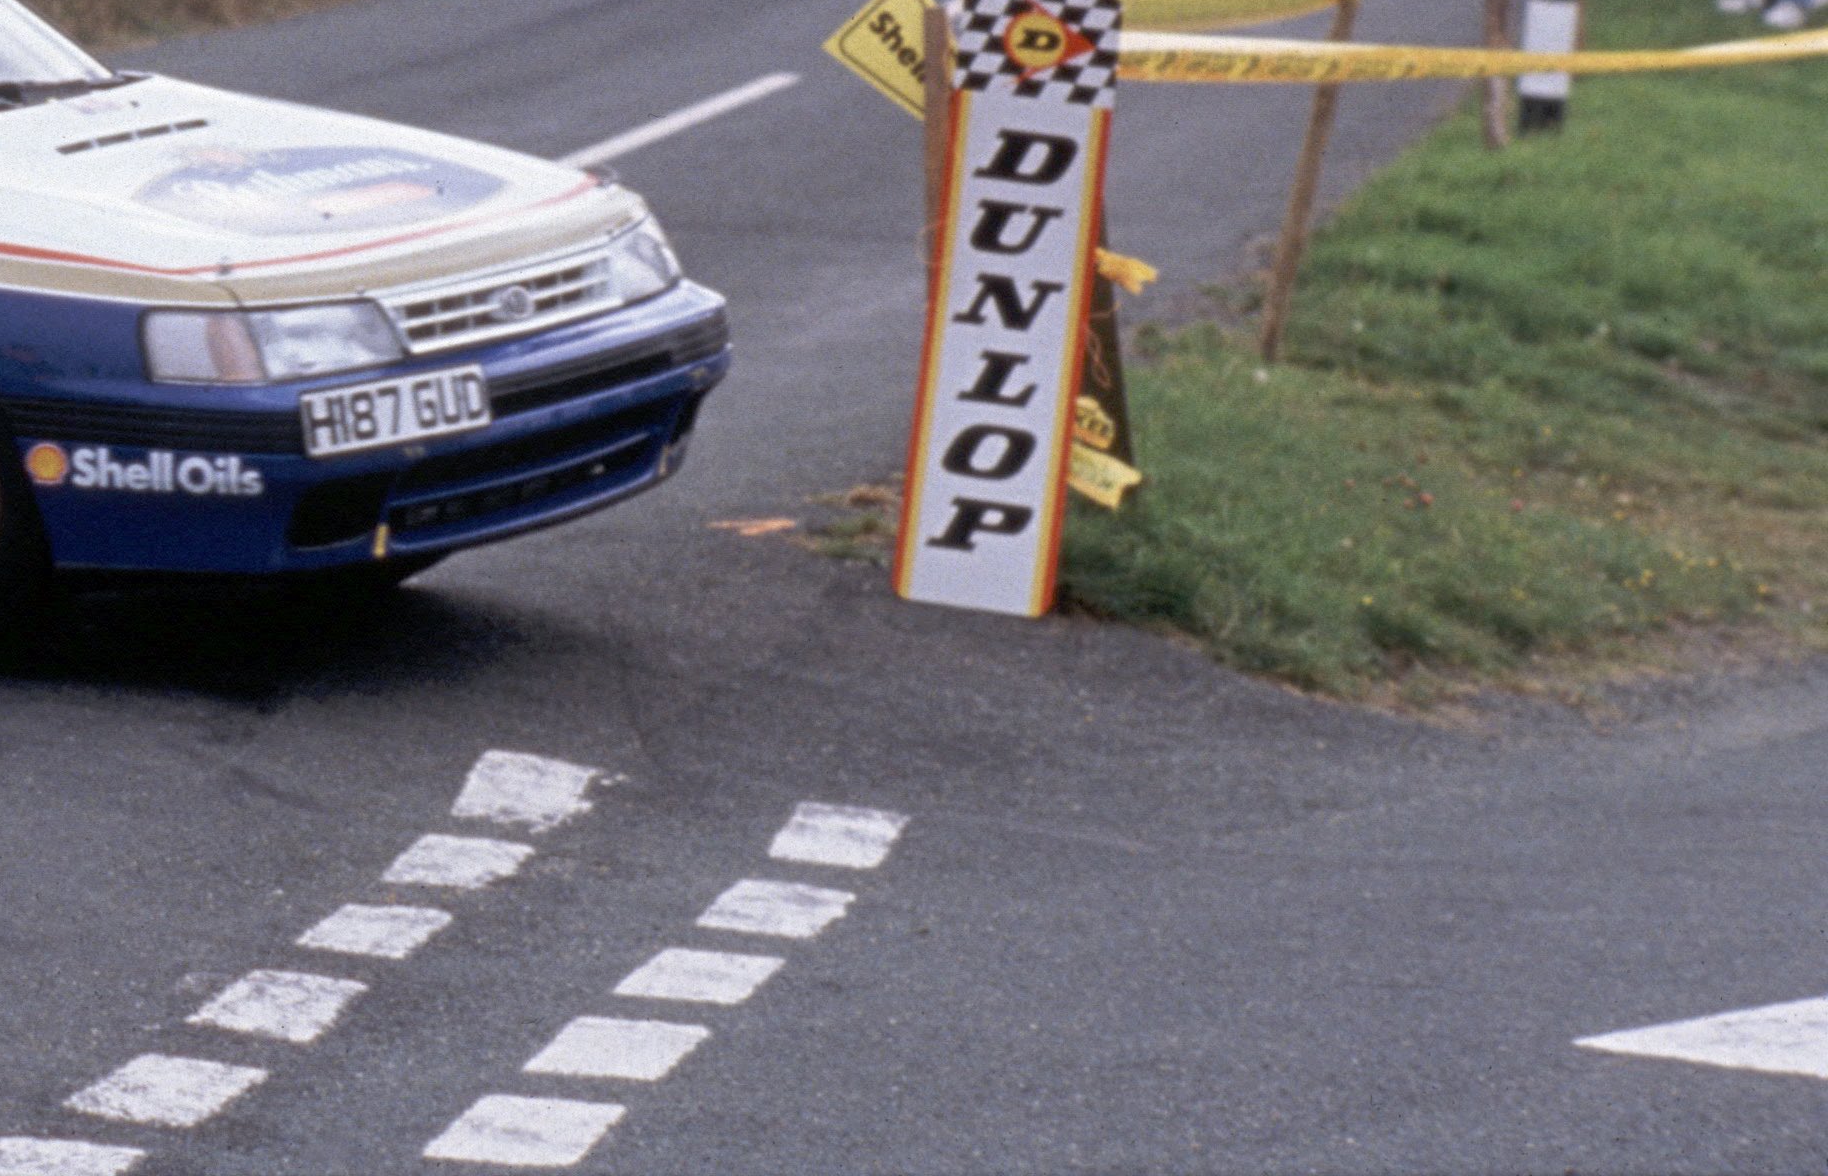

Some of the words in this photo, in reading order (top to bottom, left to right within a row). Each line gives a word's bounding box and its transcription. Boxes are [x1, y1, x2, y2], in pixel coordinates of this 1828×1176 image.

[925, 129, 1080, 552] DUNLOP
[303, 387, 402, 448] H187
[412, 372, 488, 429] GUD
[71, 446, 173, 493] Shell
[177, 455, 263, 495] Oils
